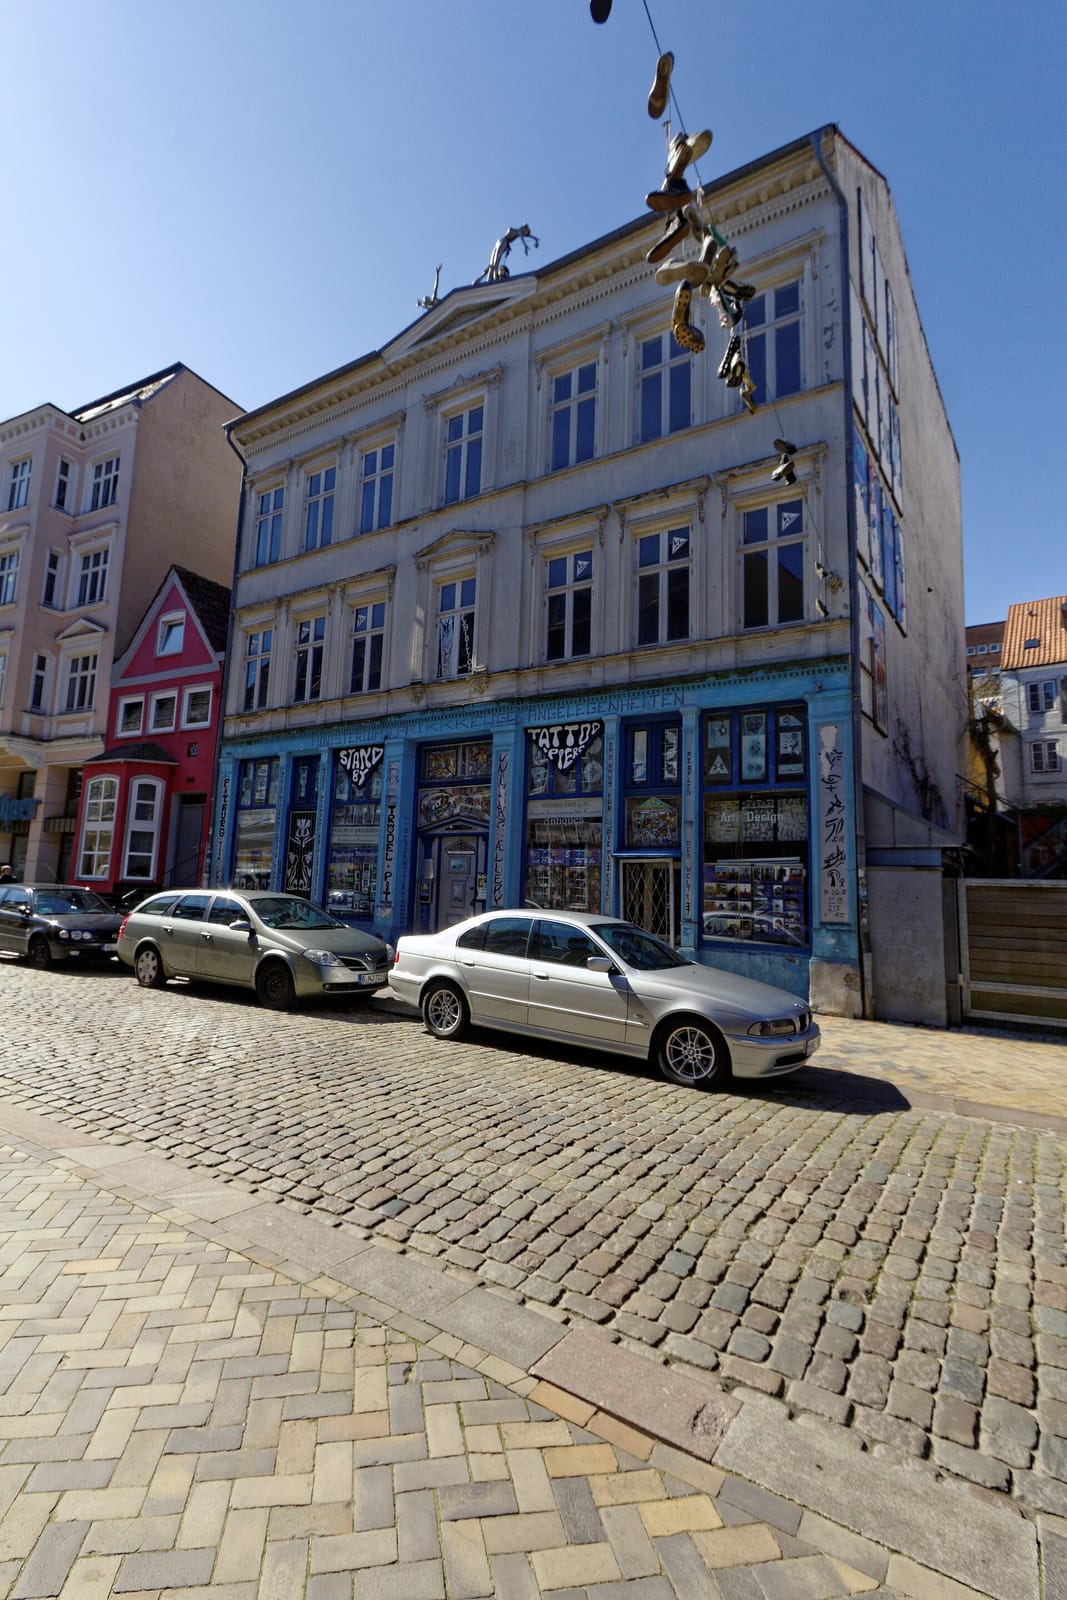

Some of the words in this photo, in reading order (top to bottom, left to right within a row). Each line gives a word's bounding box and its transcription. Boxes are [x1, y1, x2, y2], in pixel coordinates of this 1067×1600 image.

[528, 692, 685, 722] ANGELEGENHEITEN
[527, 722, 600, 748] TATTOO
[340, 747, 384, 770] STAND
[352, 769, 369, 786] BY
[543, 816, 584, 826] Antiques
[720, 811, 735, 822] Art
[746, 811, 784, 824] Design
[386, 805, 396, 861] TRÖDEL
[383, 871, 393, 901] PIT
